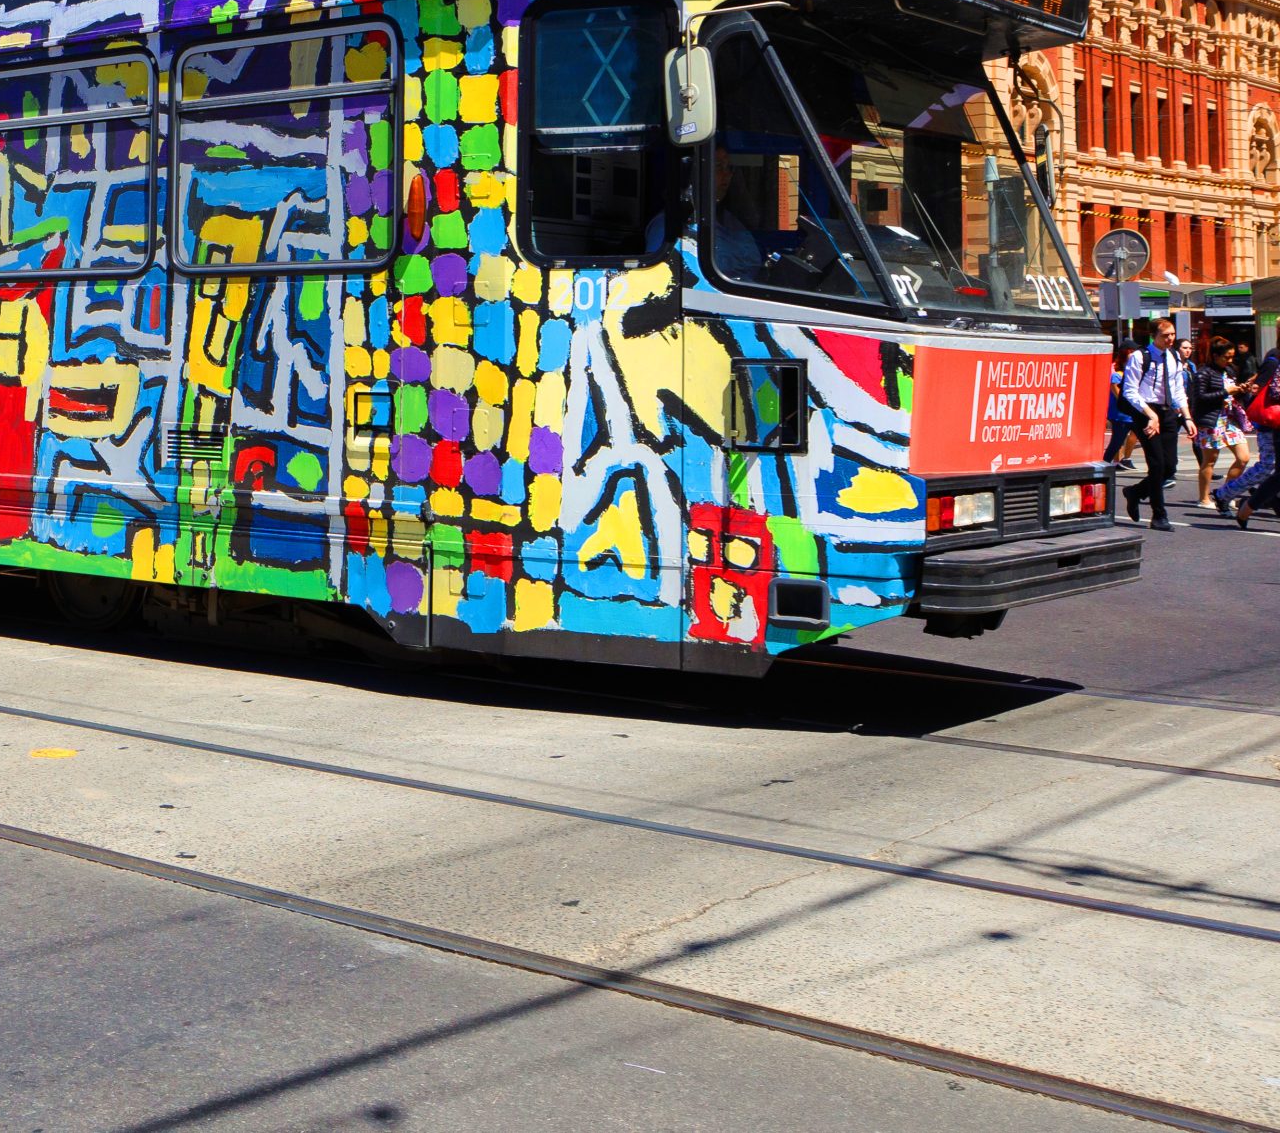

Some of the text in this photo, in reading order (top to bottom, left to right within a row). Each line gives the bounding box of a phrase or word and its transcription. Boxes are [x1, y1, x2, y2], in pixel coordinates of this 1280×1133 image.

[553, 276, 629, 311] 2012
[1025, 274, 1084, 312] 2012
[987, 361, 1069, 388] MELBOURNE
[983, 392, 1066, 421] ART TRAMS
[981, 425, 1001, 443] OCT
[1045, 423, 1063, 439] 2018
